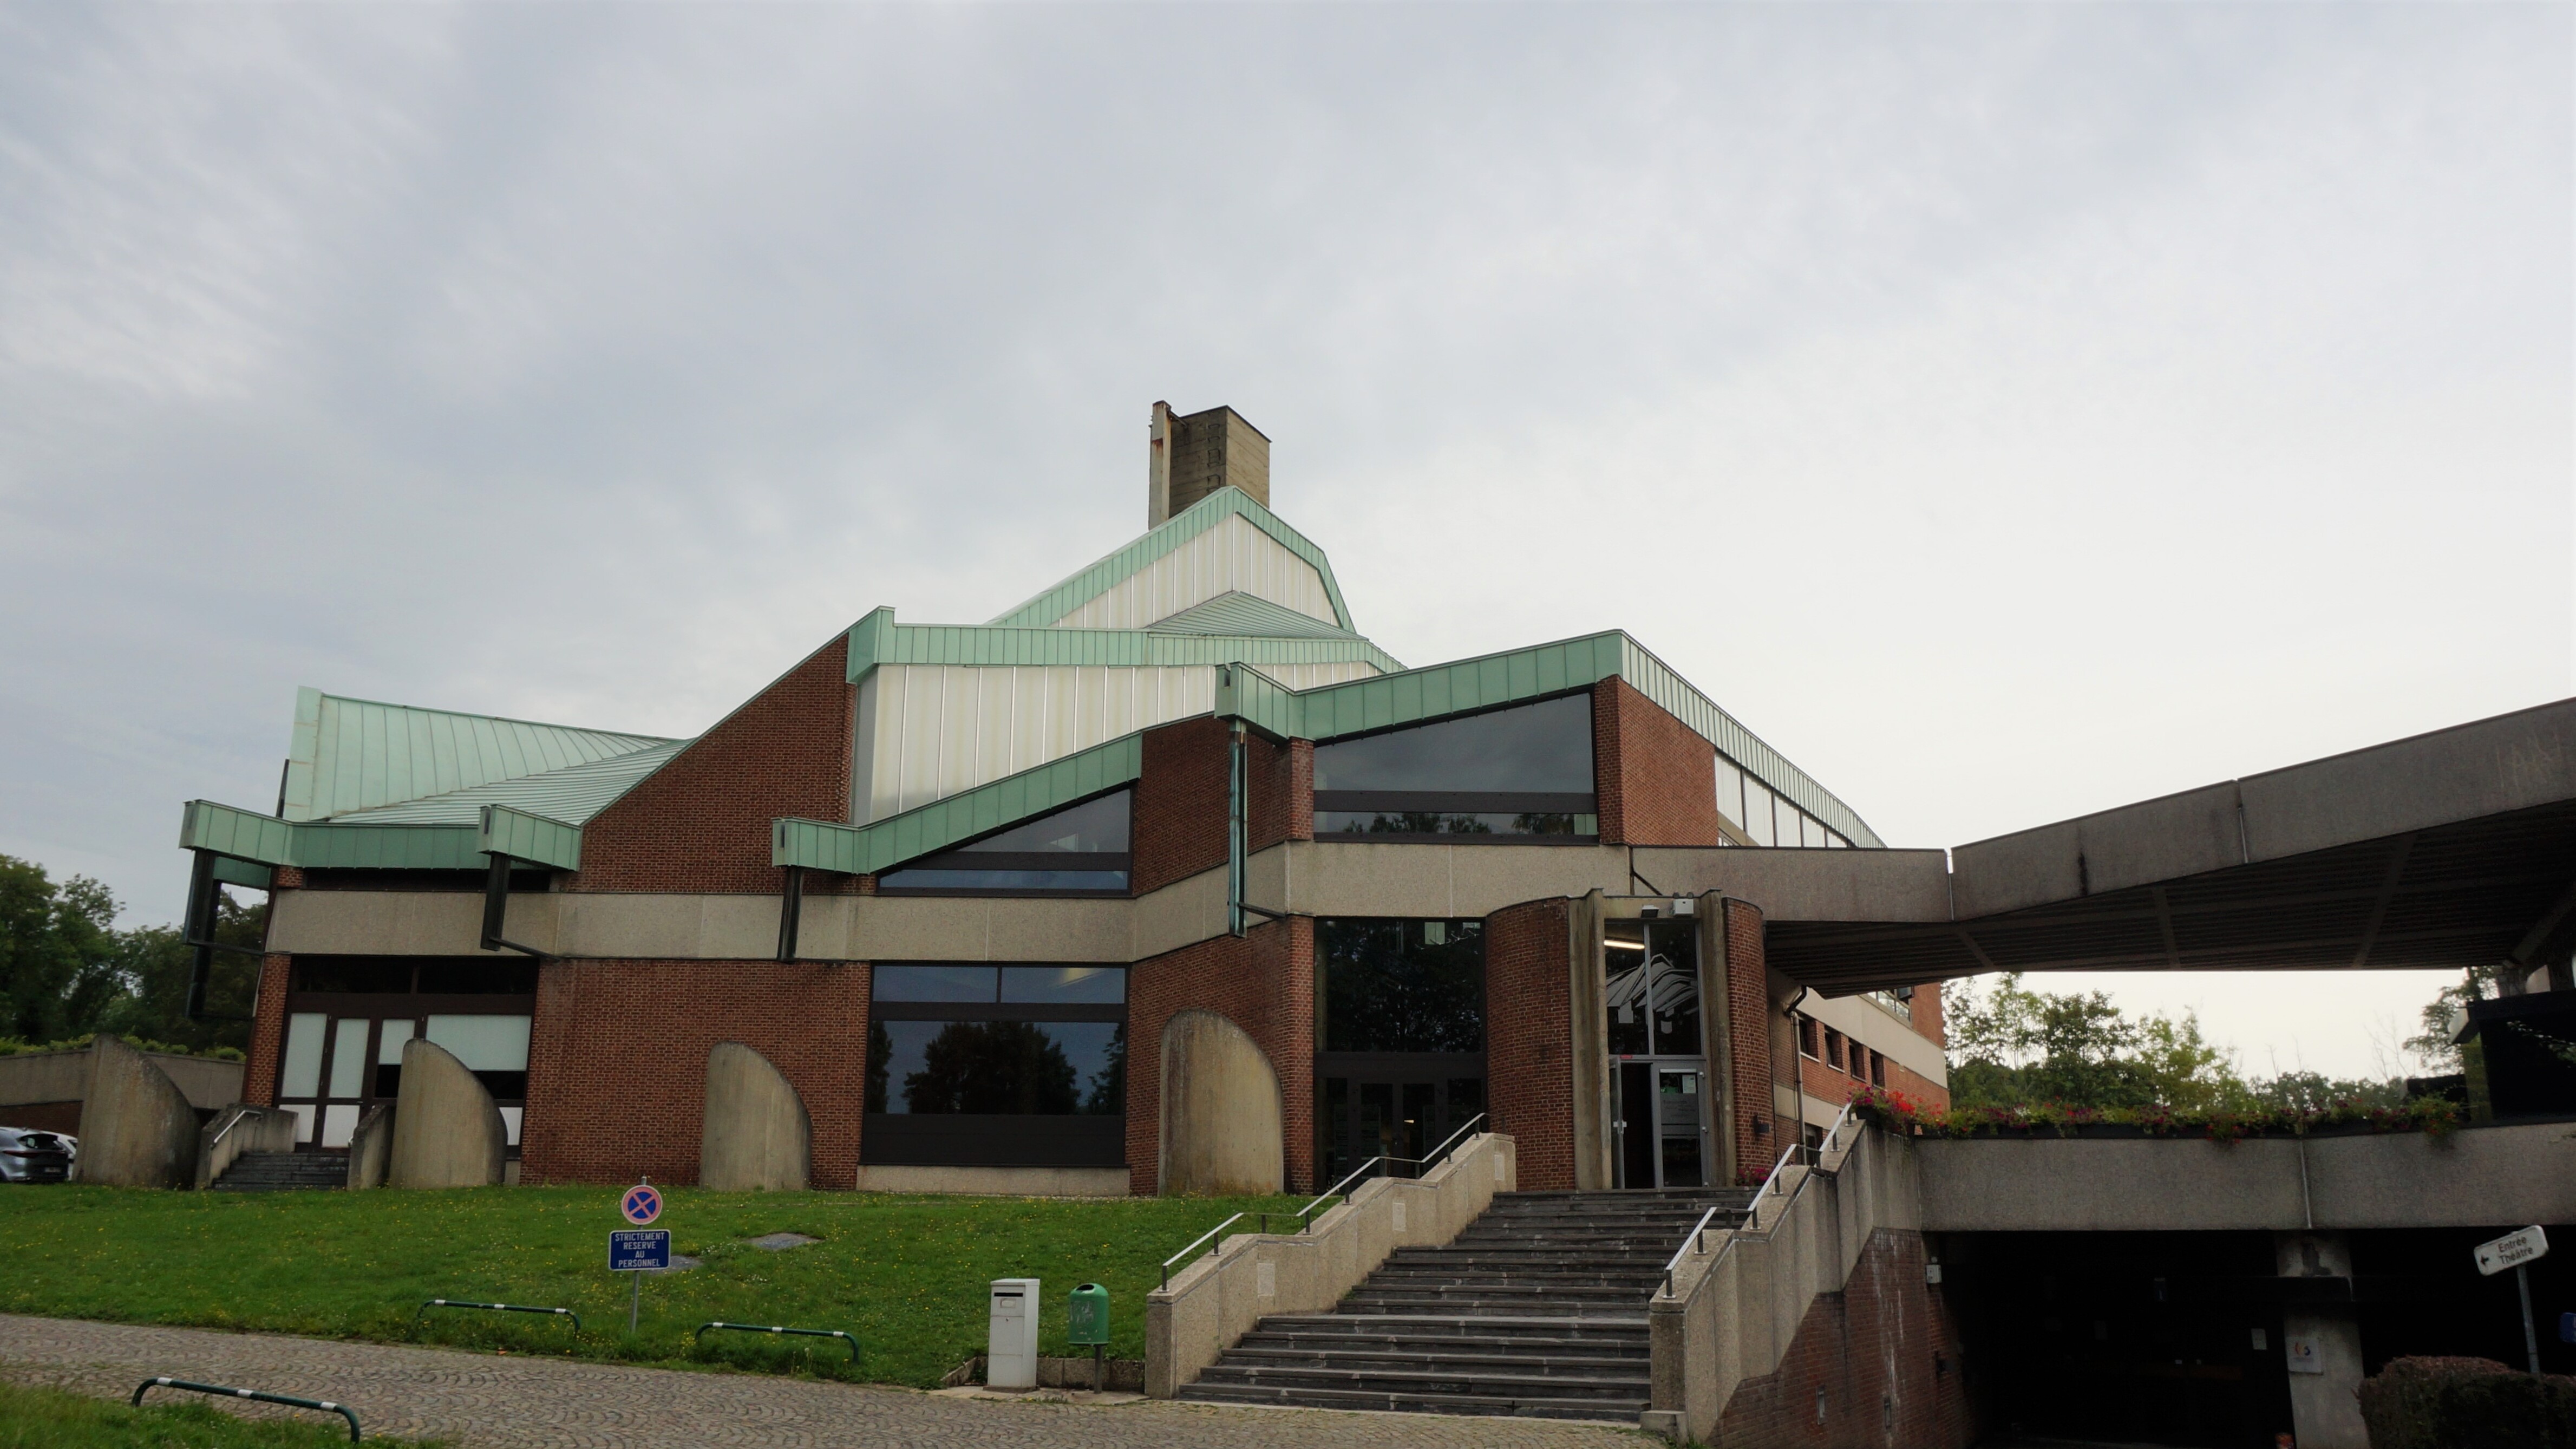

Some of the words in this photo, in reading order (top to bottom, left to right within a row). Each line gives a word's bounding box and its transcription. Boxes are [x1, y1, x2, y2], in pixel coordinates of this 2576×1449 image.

[615, 1232, 665, 1242] STRICTEMENT
[623, 1241, 656, 1250] RESERVE
[635, 1250, 645, 1258] AU
[618, 1258, 660, 1268] PERSONNEL
